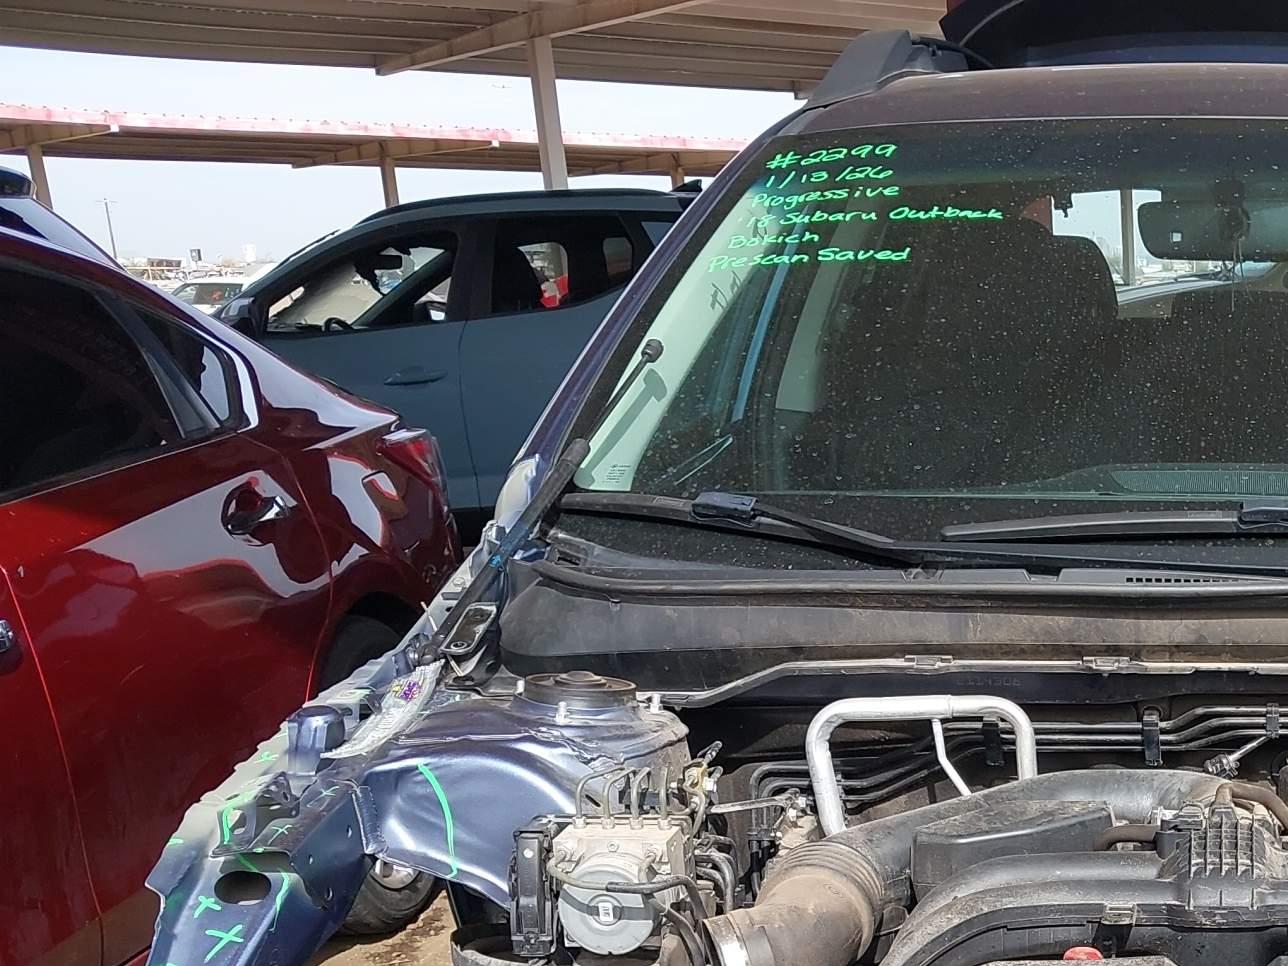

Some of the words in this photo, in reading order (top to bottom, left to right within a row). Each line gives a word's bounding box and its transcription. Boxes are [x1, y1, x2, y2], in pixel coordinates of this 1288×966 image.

[765, 143, 898, 169] #2299
[751, 184, 900, 210] Progressive
[779, 210, 878, 225] Subaru
[889, 205, 1004, 221] Outback
[708, 253, 810, 273] Prescan
[817, 247, 912, 262] Saved
